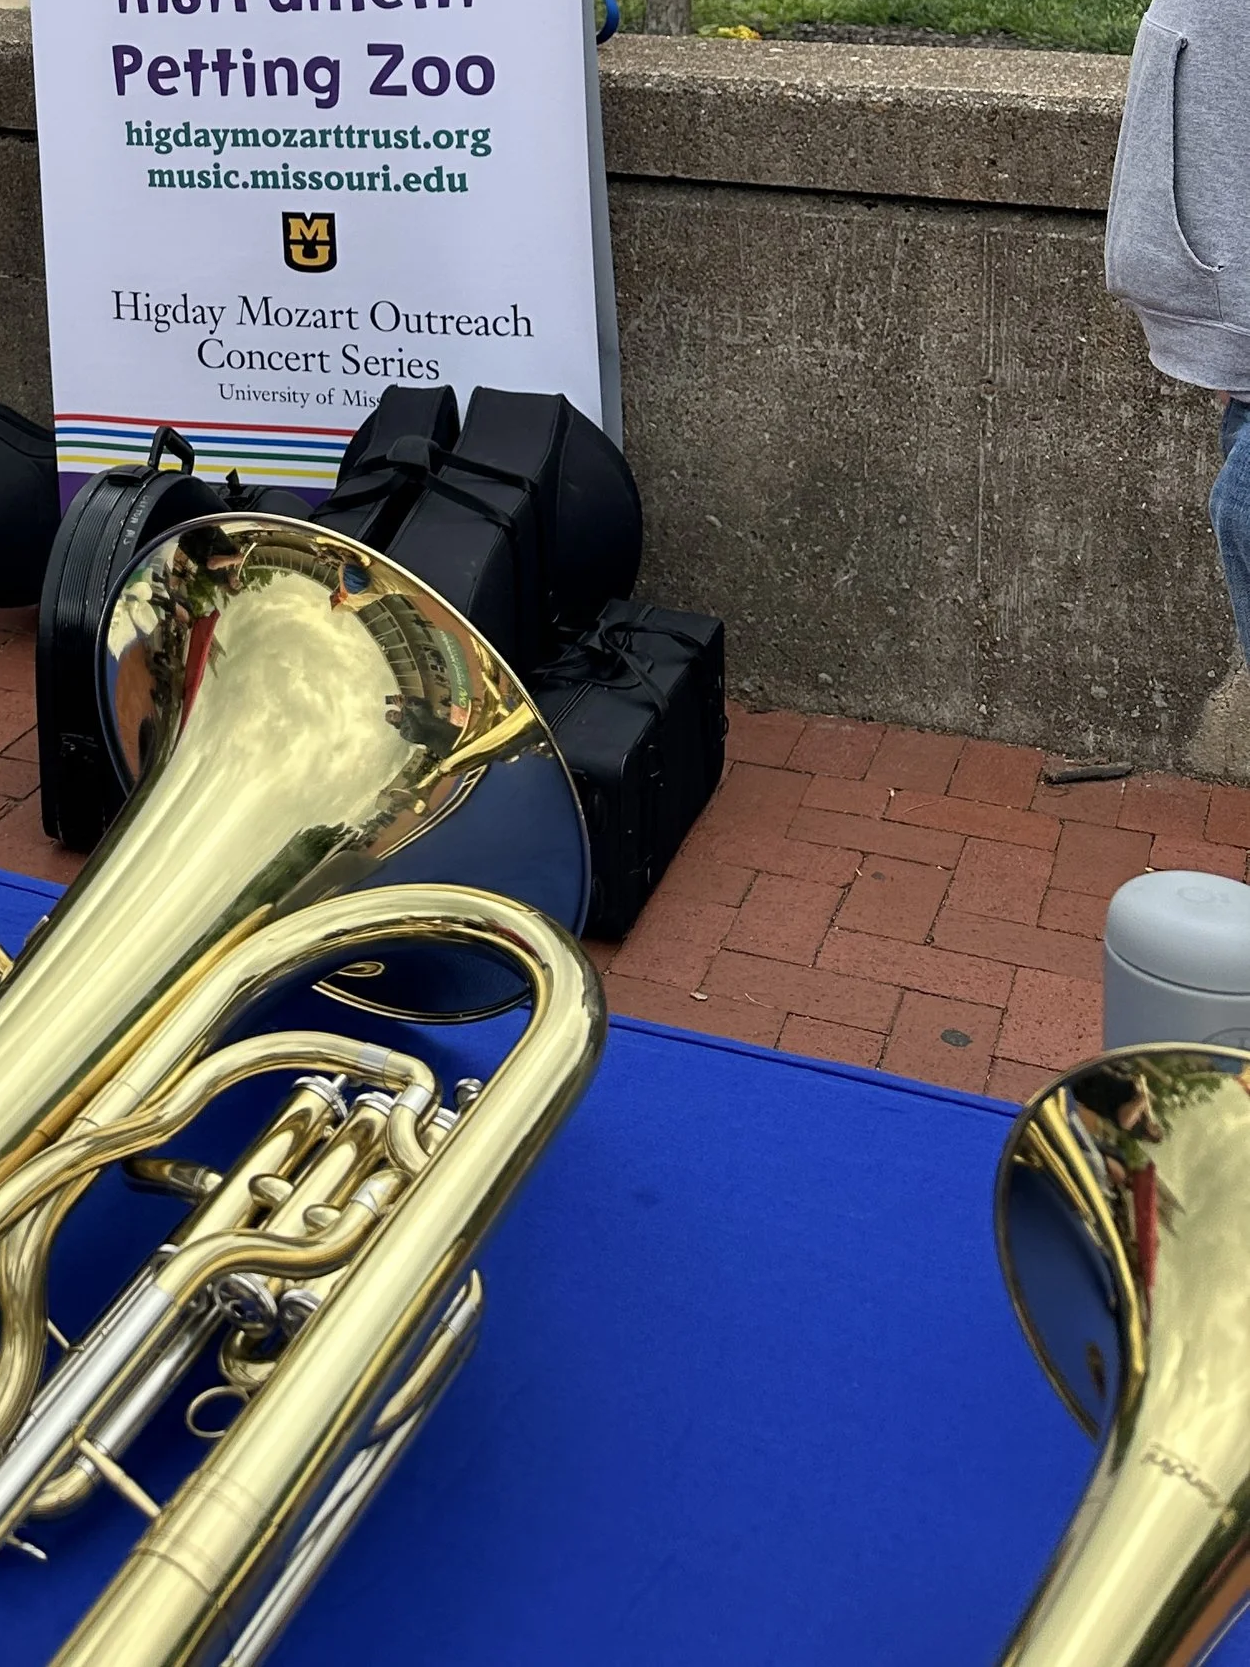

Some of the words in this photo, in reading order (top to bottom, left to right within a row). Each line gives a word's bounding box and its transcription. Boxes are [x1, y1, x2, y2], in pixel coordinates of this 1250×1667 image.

[111, 44, 341, 110] Petting
[366, 43, 496, 97] Zoo
[124, 120, 492, 157] higdaymozarttrust.org
[147, 163, 469, 193] music.missouri.edu
[111, 290, 227, 334] Higday
[236, 295, 360, 331] Mozart
[369, 300, 534, 337] Outreach
[197, 337, 331, 374] Concert
[341, 344, 440, 381] Series
[218, 383, 310, 409] University
[315, 387, 336, 405] of
[342, 389, 382, 409] Miss
